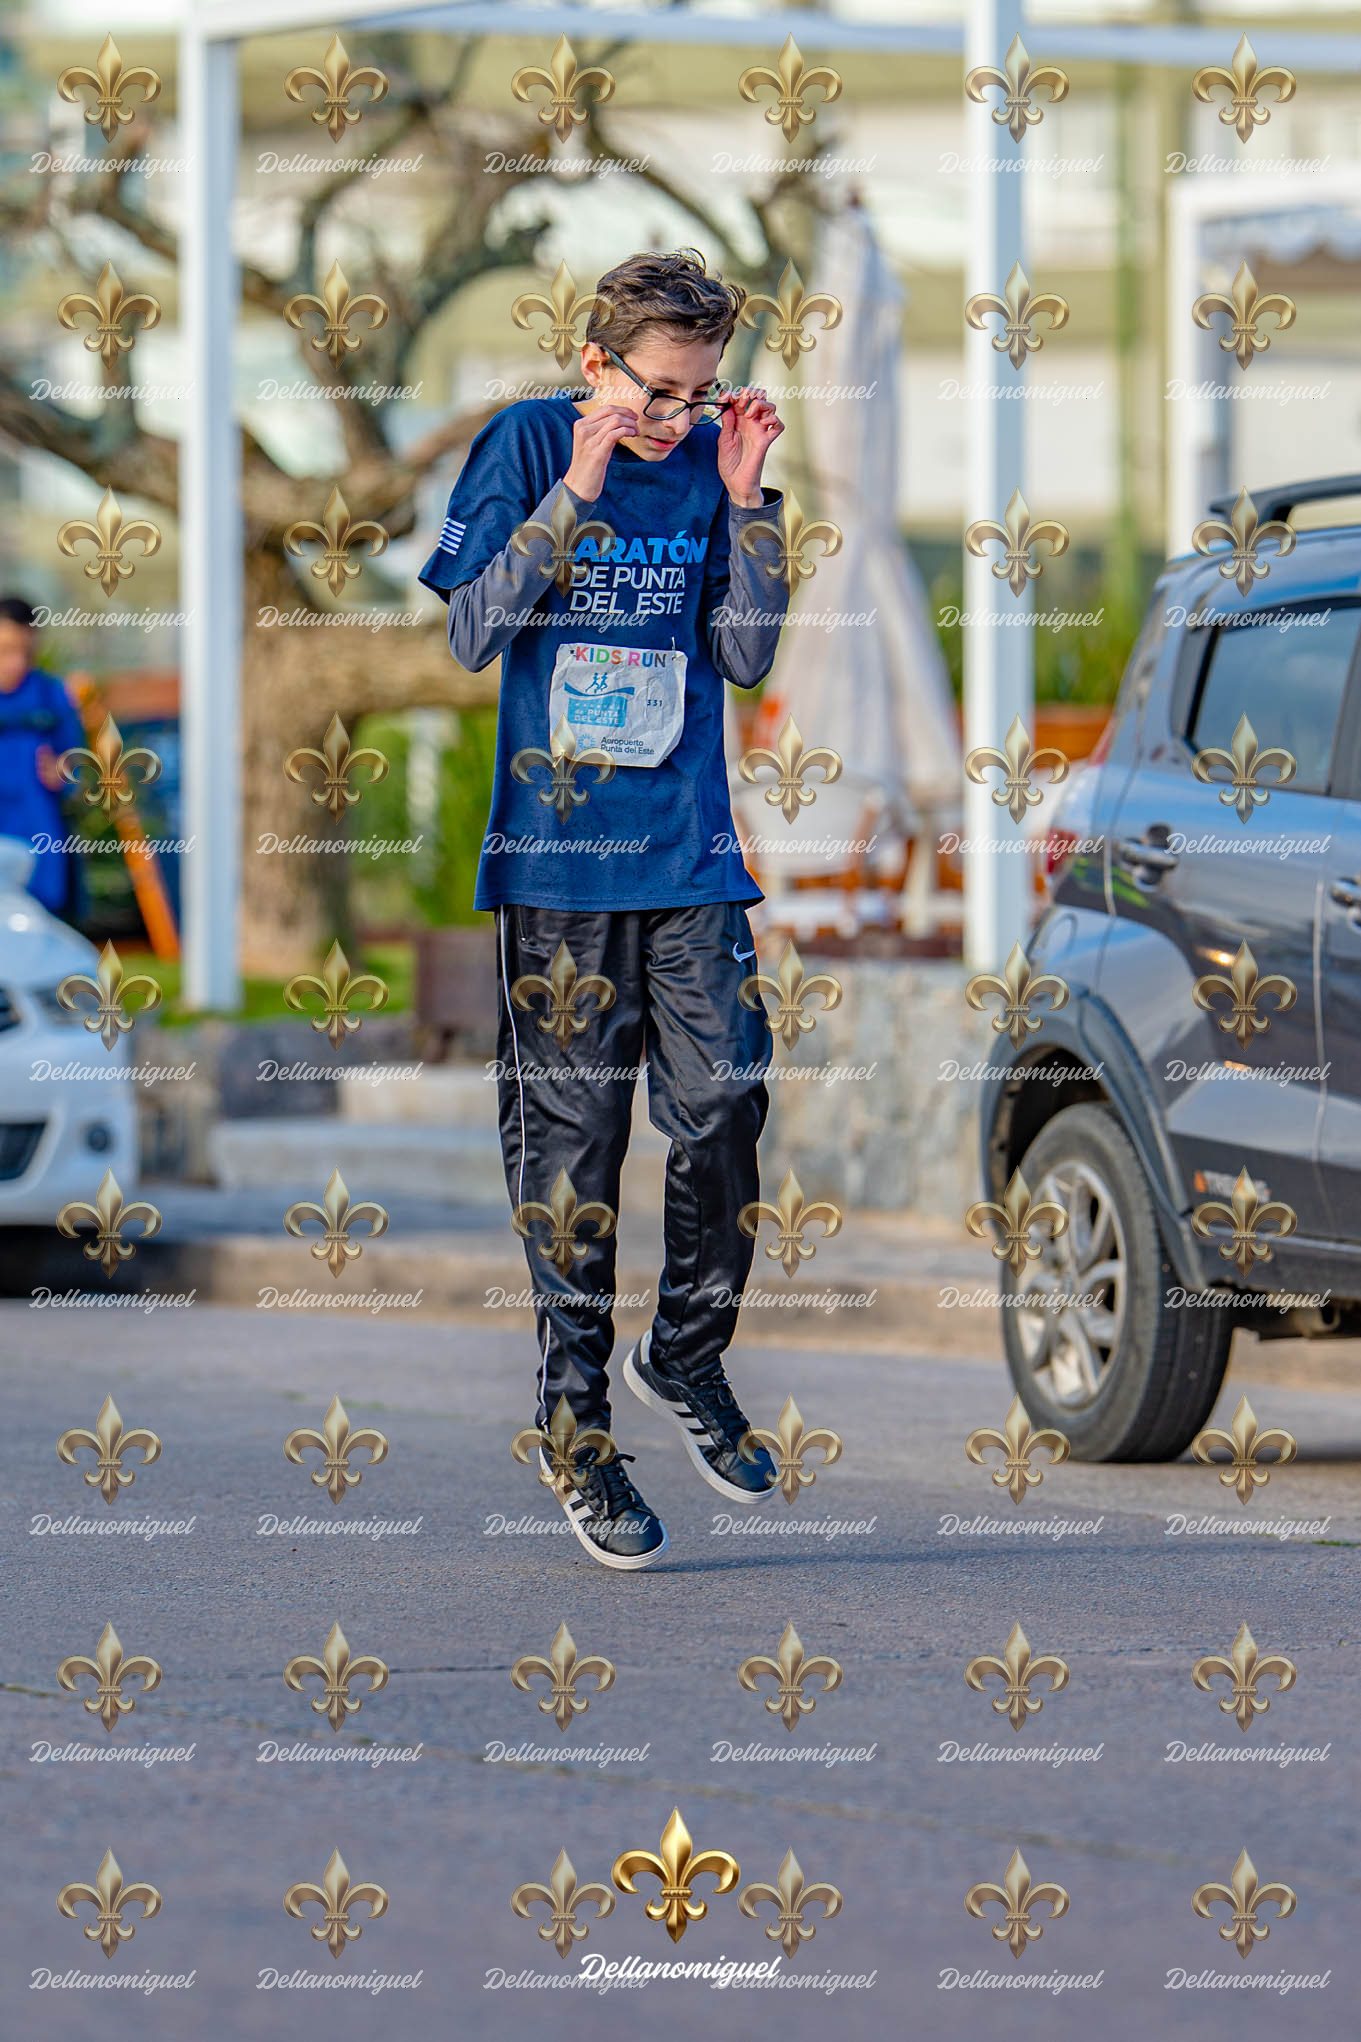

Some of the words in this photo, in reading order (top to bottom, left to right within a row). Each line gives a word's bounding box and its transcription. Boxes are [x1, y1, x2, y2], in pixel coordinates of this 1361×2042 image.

[573, 530, 709, 564] ARATÓN
[569, 566, 610, 588] DE
[612, 566, 686, 590] PUNTA
[569, 591, 625, 614] DEL
[635, 592, 685, 615] ESTE
[575, 646, 623, 665] KIDS
[627, 650, 667, 668] RUN
[646, 699, 663, 708] 331
[600, 736, 644, 747] Aeropuerto
[600, 744, 623, 753] Punta
[624, 746, 637, 754] del
[638, 747, 655, 755] Este
